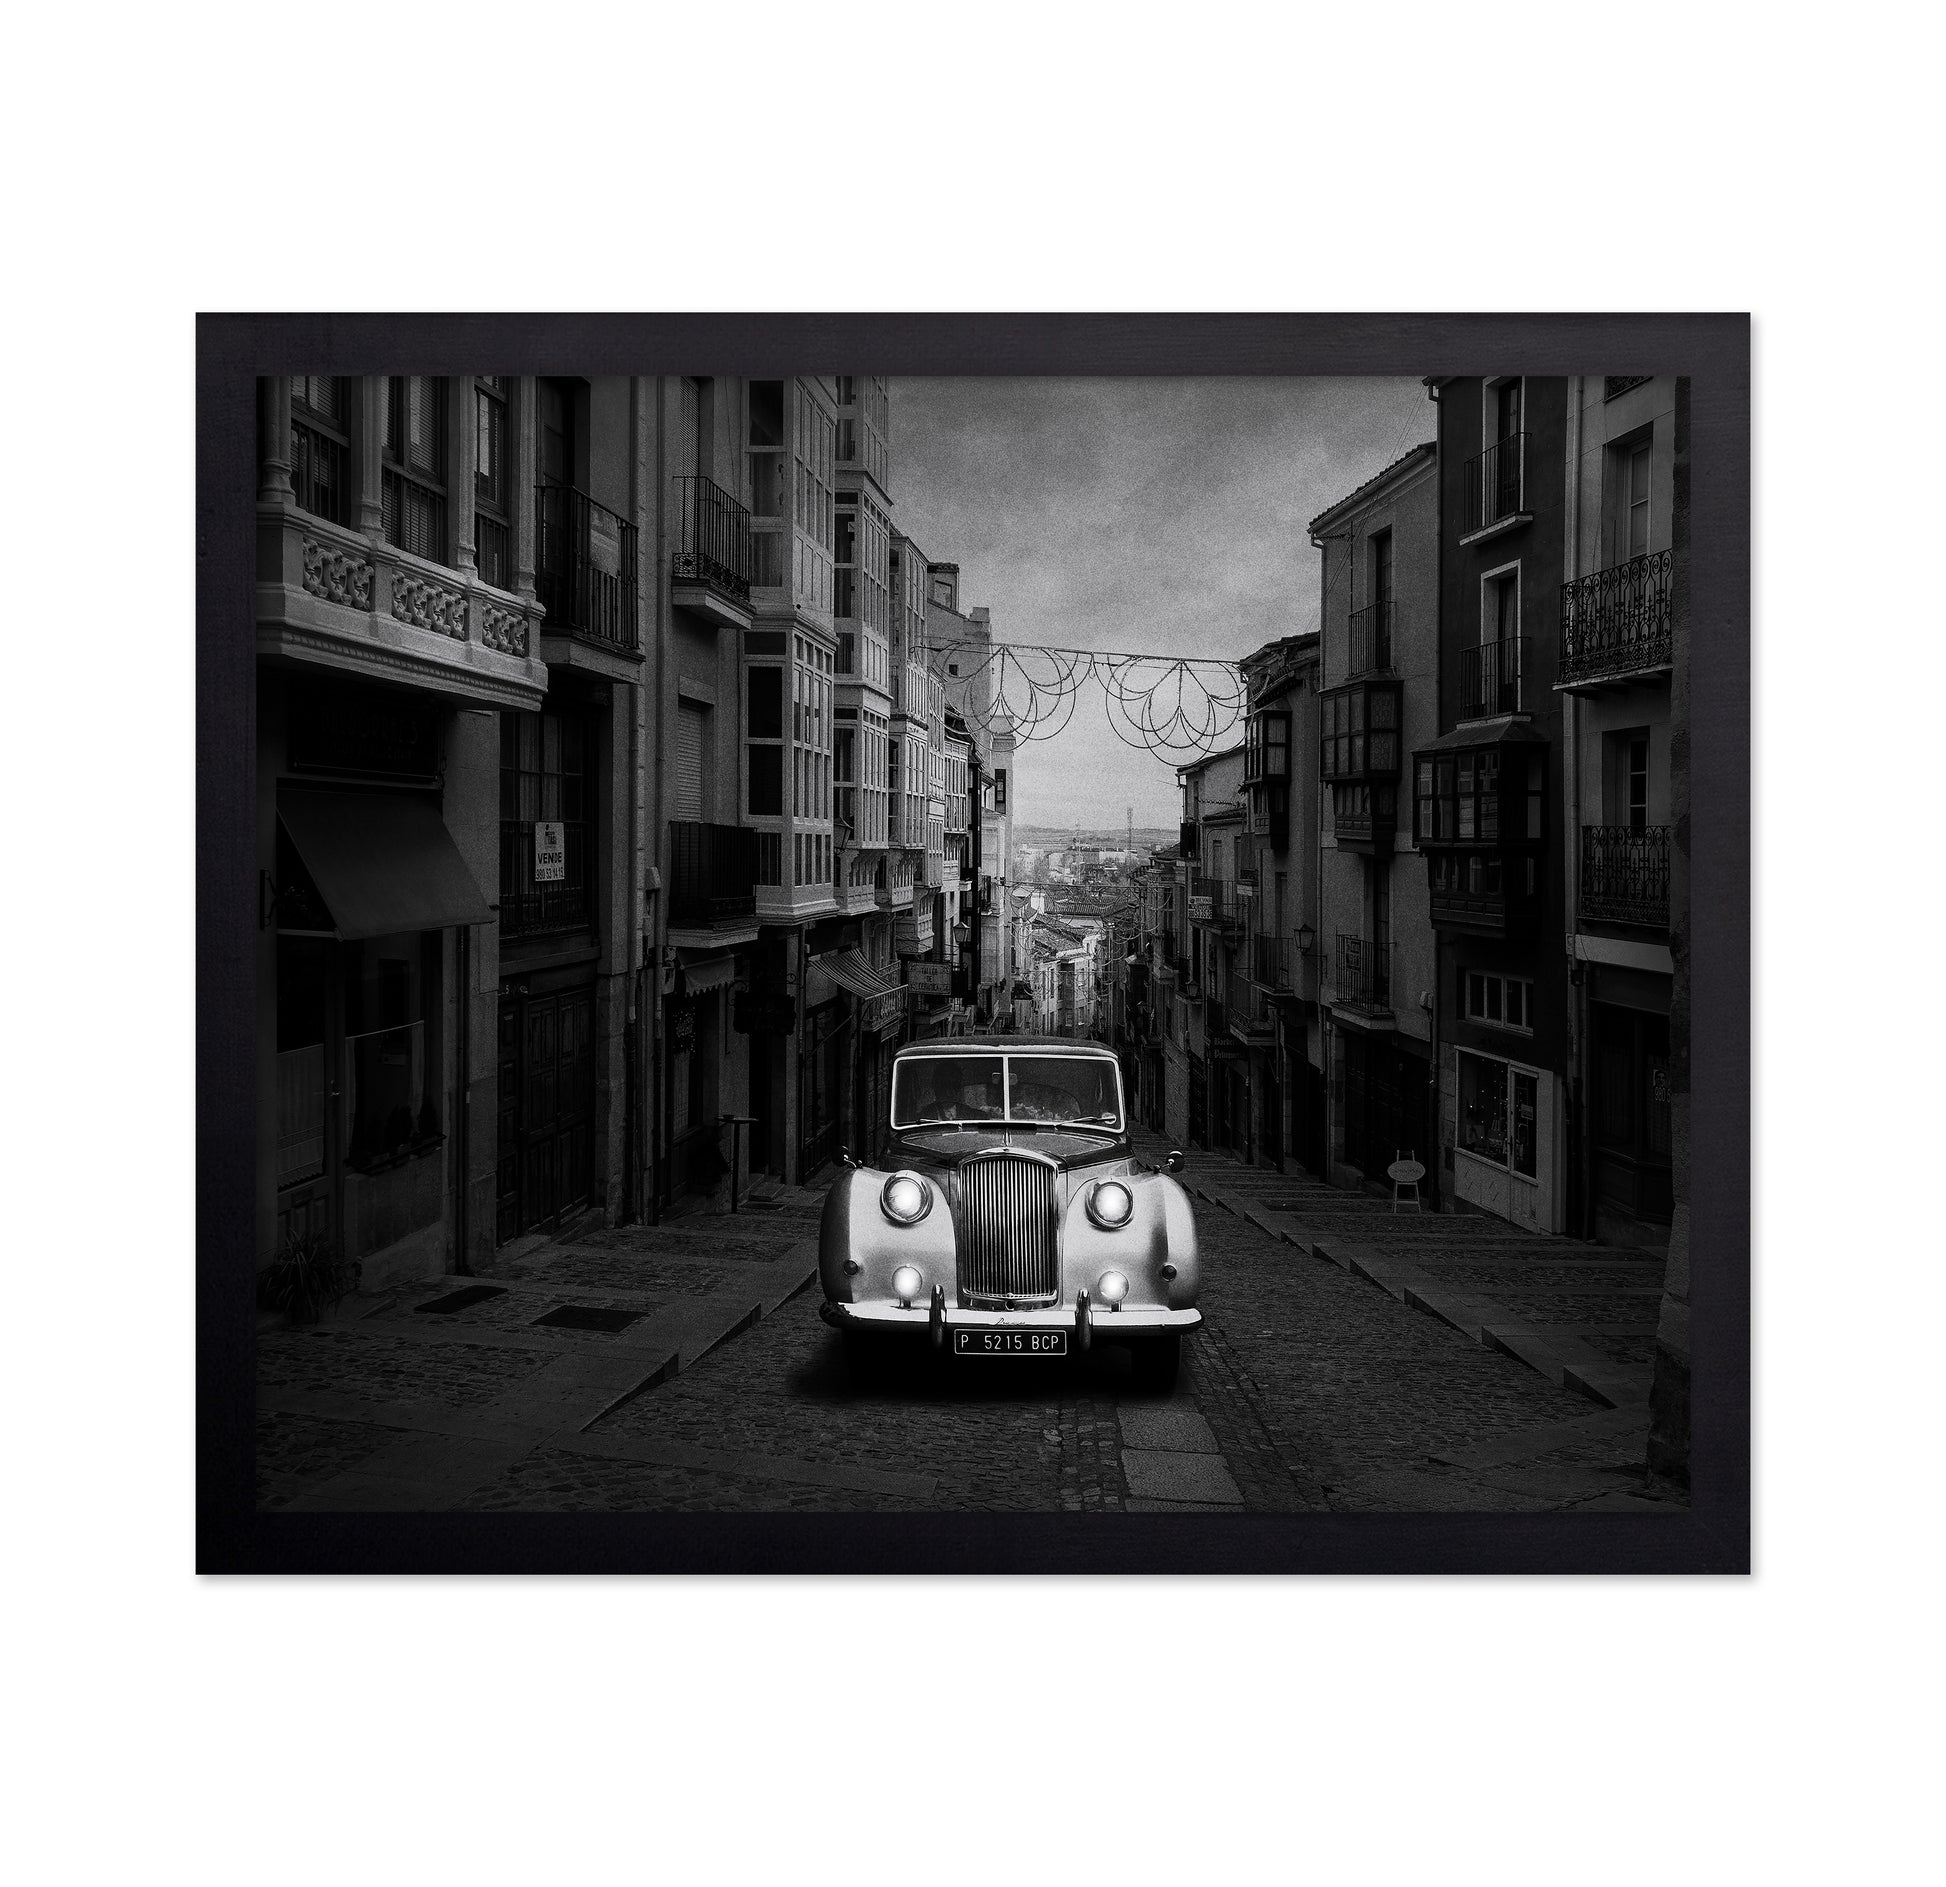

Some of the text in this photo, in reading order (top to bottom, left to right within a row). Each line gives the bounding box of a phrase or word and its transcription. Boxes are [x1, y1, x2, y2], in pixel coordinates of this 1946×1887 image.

[537, 852, 562, 865] VENDE
[961, 1334, 1059, 1350] P 5215 BCP
